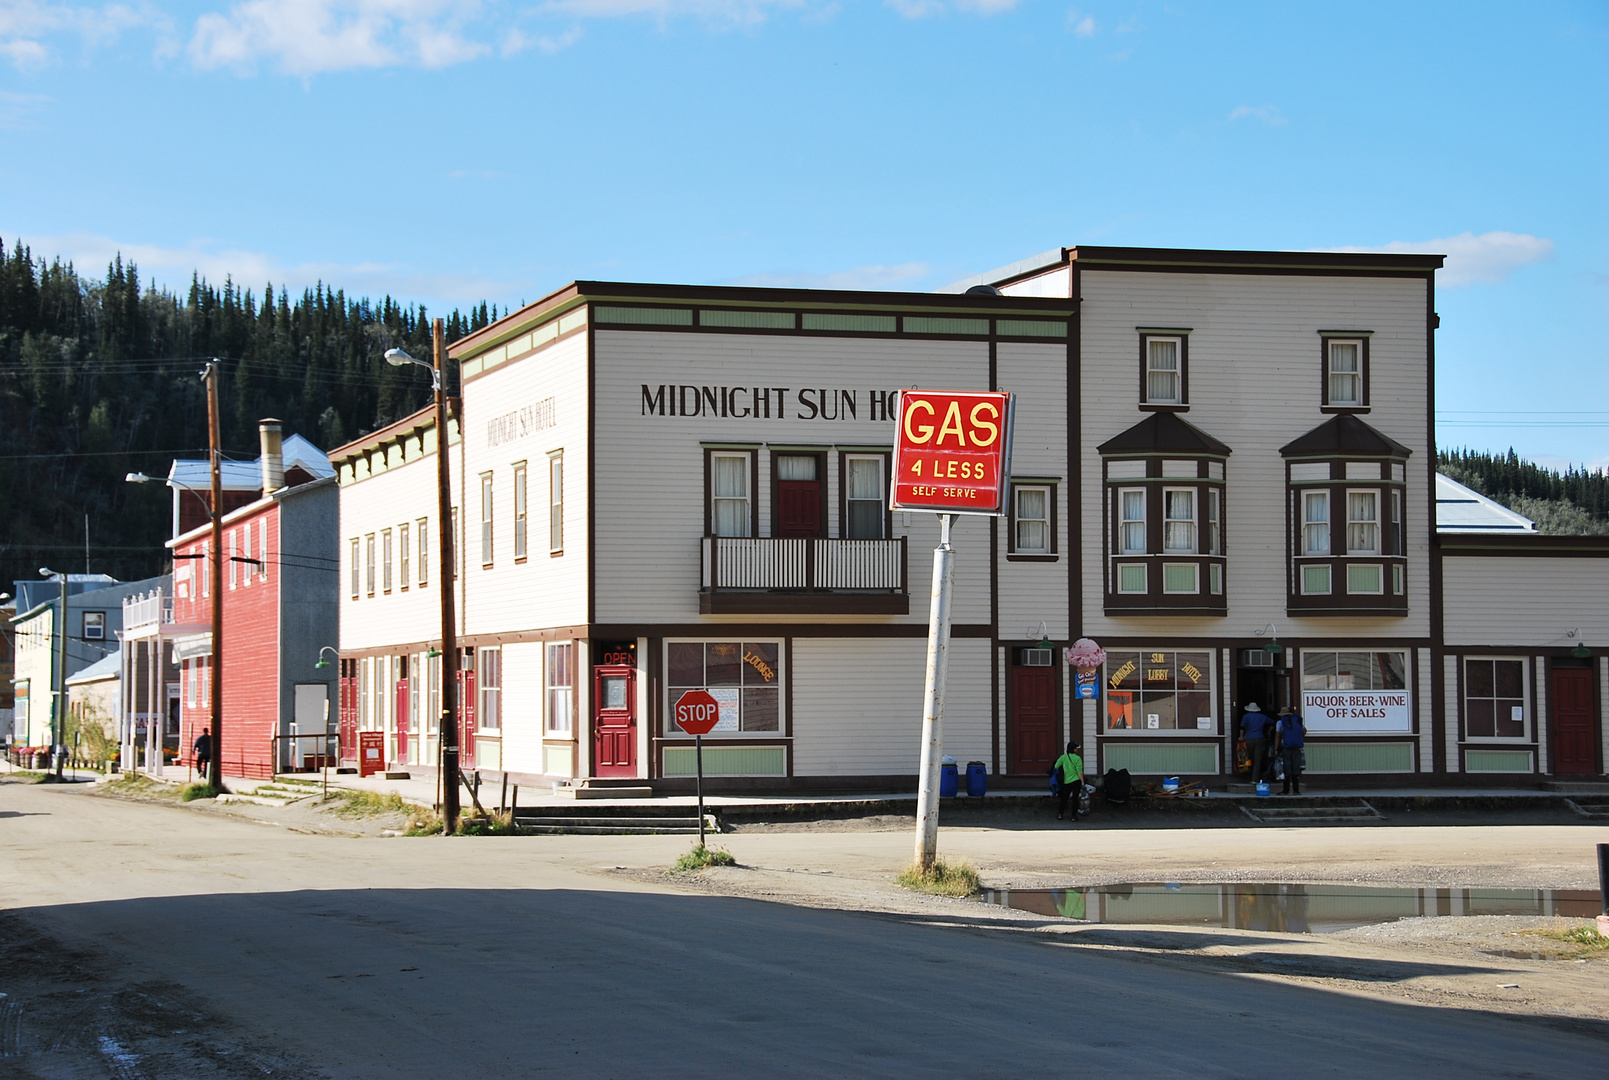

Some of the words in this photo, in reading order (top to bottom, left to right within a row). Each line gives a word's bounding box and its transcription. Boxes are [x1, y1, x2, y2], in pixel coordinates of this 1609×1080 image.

[641, 385, 791, 419] MIDNIGHT
[798, 389, 856, 421] SUN
[904, 400, 999, 447] GAS
[911, 459, 923, 476] 4
[933, 461, 985, 480] LESS
[911, 486, 938, 498] SELF
[943, 488, 977, 499] SERVE
[604, 652, 636, 665] OPEN
[743, 651, 775, 682] LOUNGE
[1109, 660, 1137, 690] MIDNIGHT
[1151, 653, 1165, 663] SUN
[1181, 661, 1202, 684] HOTEL
[1147, 669, 1169, 681] LOBBY
[1306, 696, 1346, 708] LIQUOR
[1349, 696, 1376, 707] BEER
[1379, 695, 1406, 706] WINE
[678, 703, 716, 722] STOP
[1326, 708, 1348, 719] OFF
[1351, 708, 1387, 719] SALES
